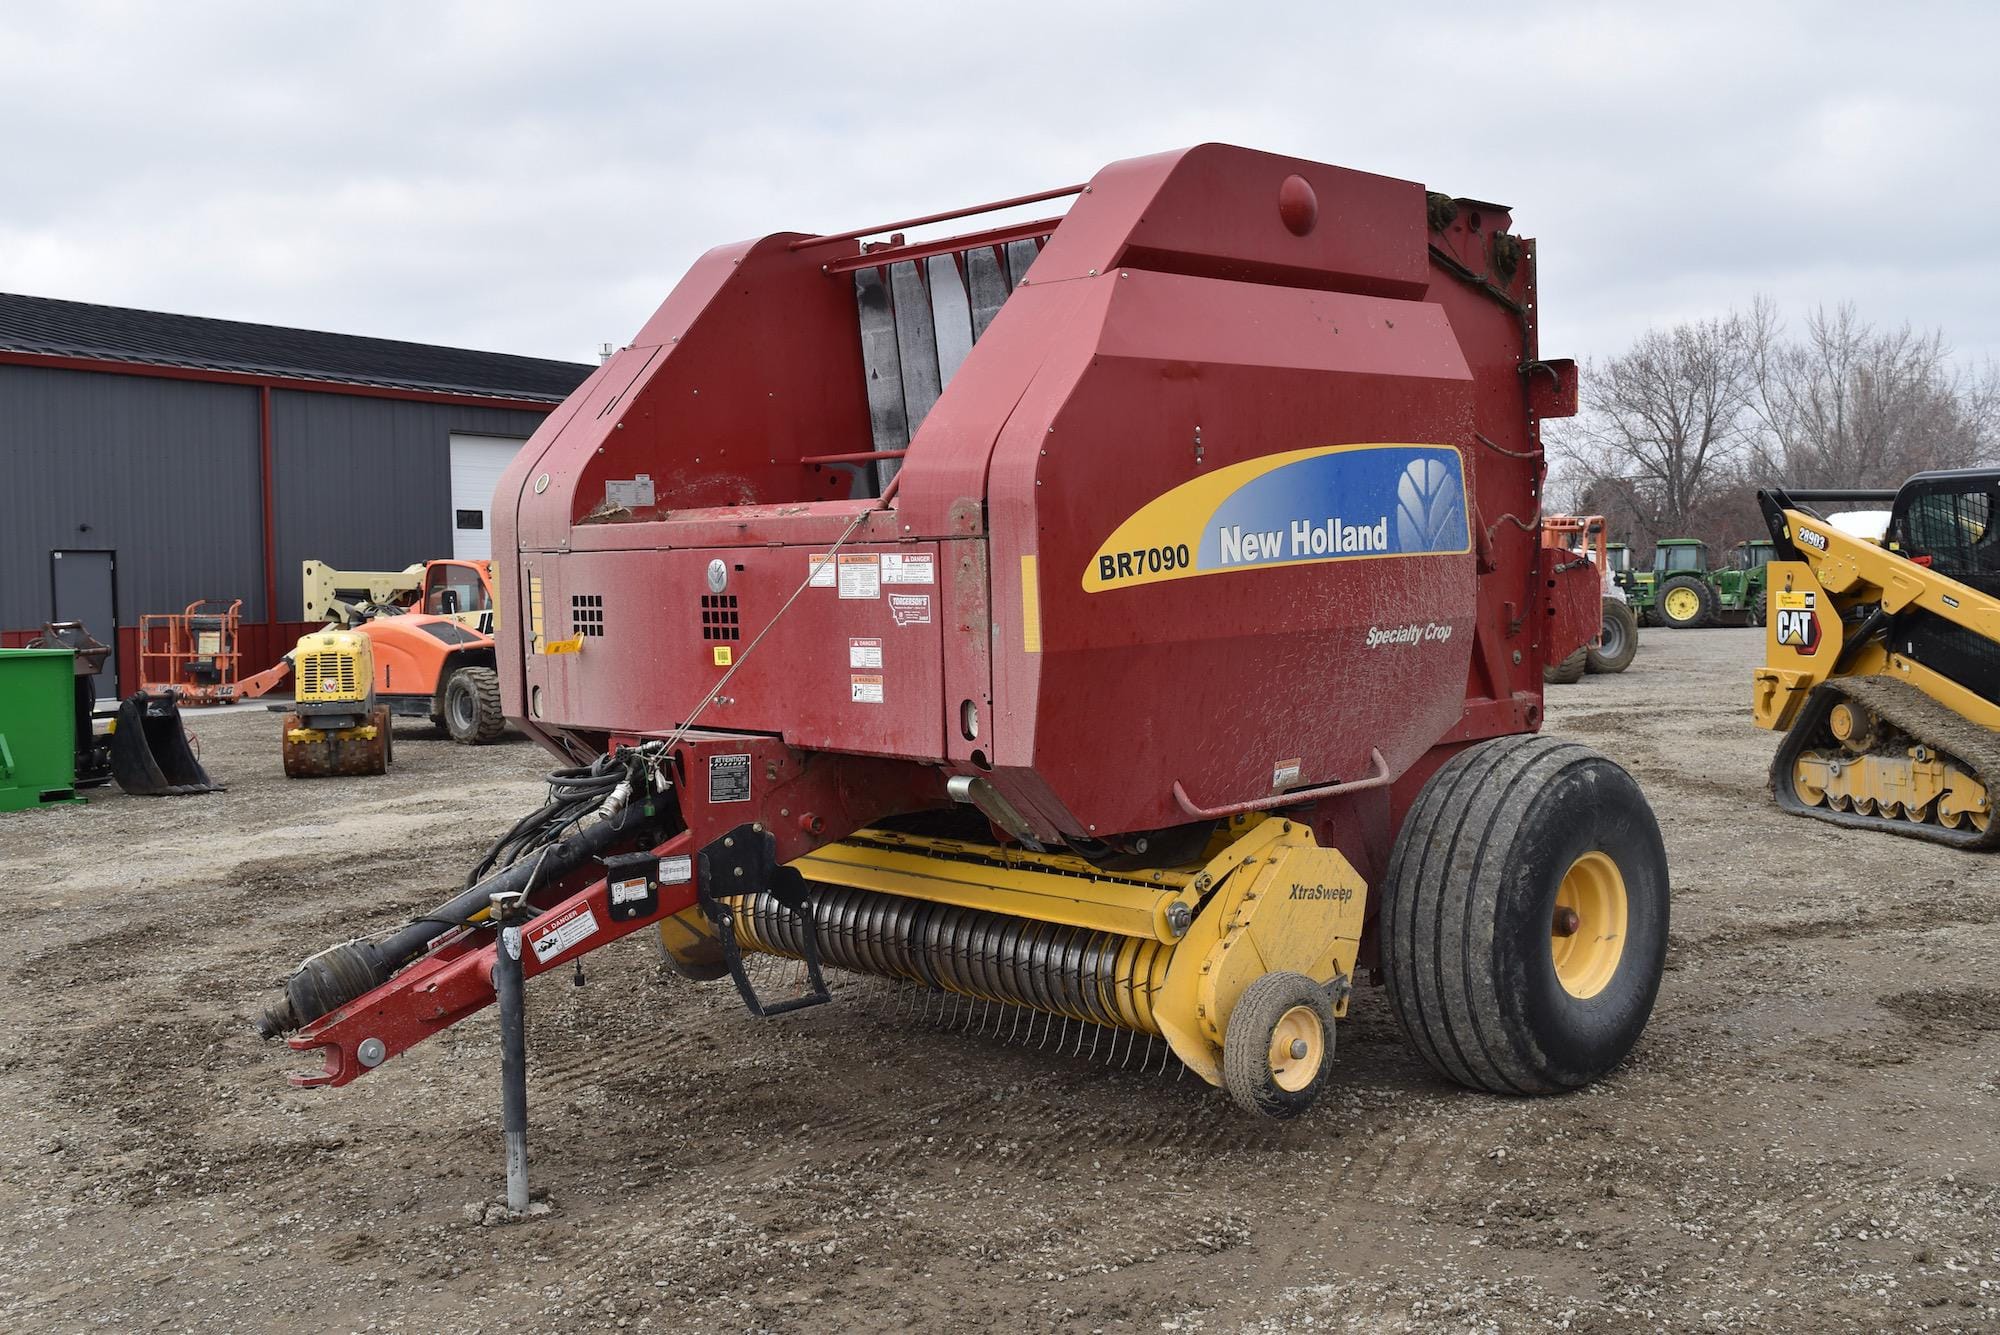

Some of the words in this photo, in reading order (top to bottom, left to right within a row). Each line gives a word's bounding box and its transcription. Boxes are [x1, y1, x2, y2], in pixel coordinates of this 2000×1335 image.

[1220, 525, 1283, 564] New
[1291, 516, 1388, 556] Holland
[1799, 527, 1826, 550] 289D3
[1099, 543, 1190, 581] BR7090
[1366, 624, 1423, 649] Specialty
[1424, 622, 1452, 643] Crop
[1777, 610, 1812, 645] CAT
[1289, 883, 1353, 904] XtraSweep
[550, 910, 578, 930] DANGER
